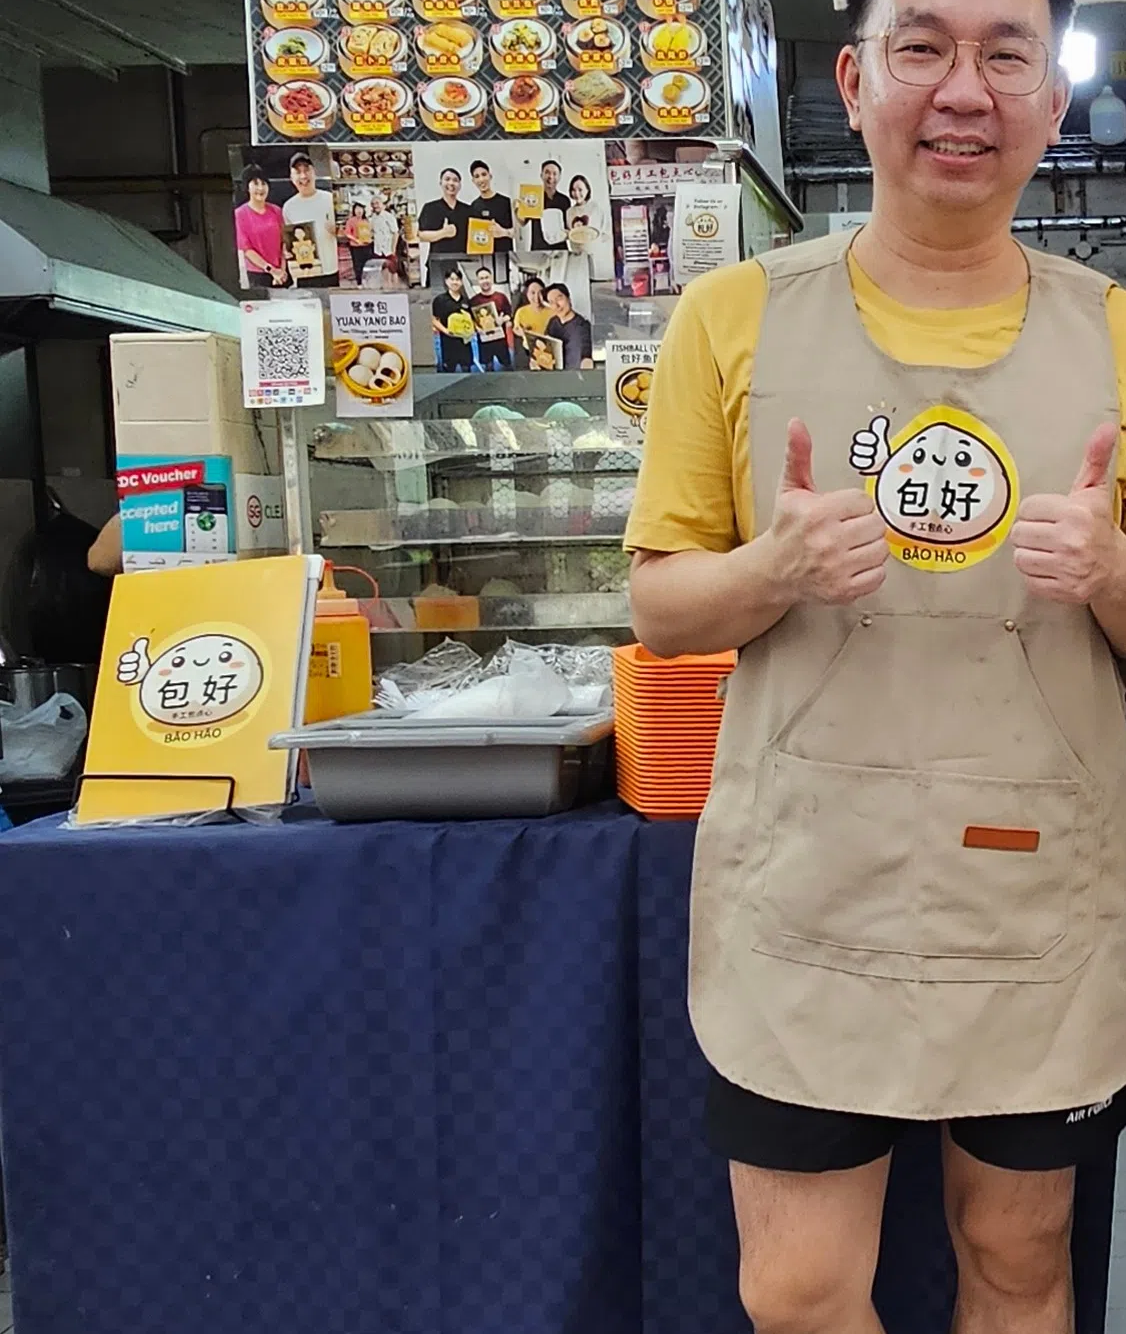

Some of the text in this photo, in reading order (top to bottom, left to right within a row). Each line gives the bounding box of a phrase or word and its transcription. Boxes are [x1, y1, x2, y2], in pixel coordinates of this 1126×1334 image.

[336, 316, 407, 327] YUAN YANG BAO
[141, 468, 198, 486] Voucher
[896, 478, 981, 522] 包好
[120, 500, 178, 522] ccepted
[144, 518, 179, 535] here
[157, 673, 239, 709] 包好
[1065, 1109, 1087, 1125] AIR
